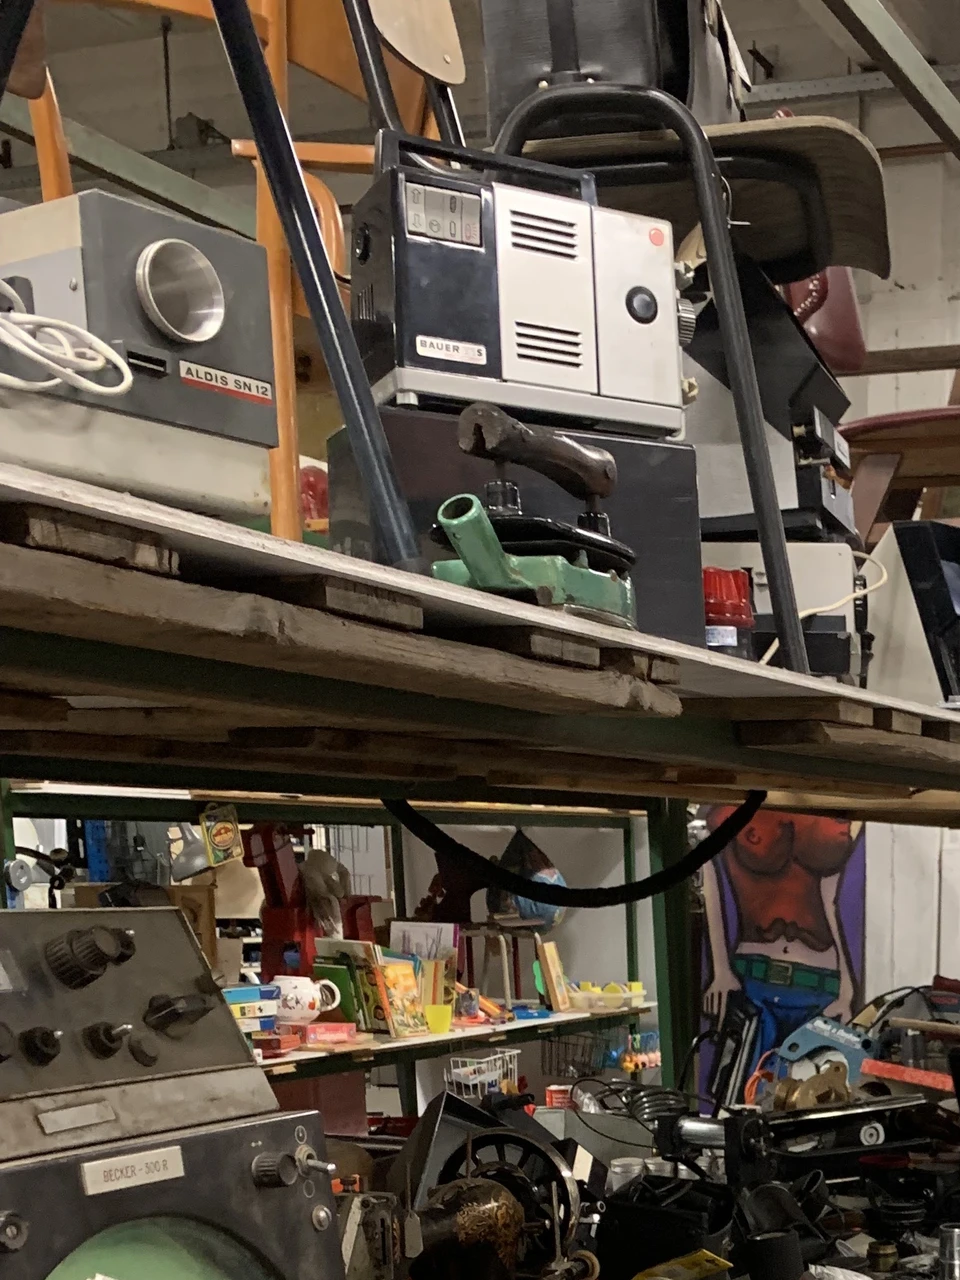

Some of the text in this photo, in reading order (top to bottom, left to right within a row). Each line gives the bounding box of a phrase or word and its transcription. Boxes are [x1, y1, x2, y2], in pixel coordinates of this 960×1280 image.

[420, 340, 460, 353] BAUER
[185, 367, 268, 396] ALDIS SN 12
